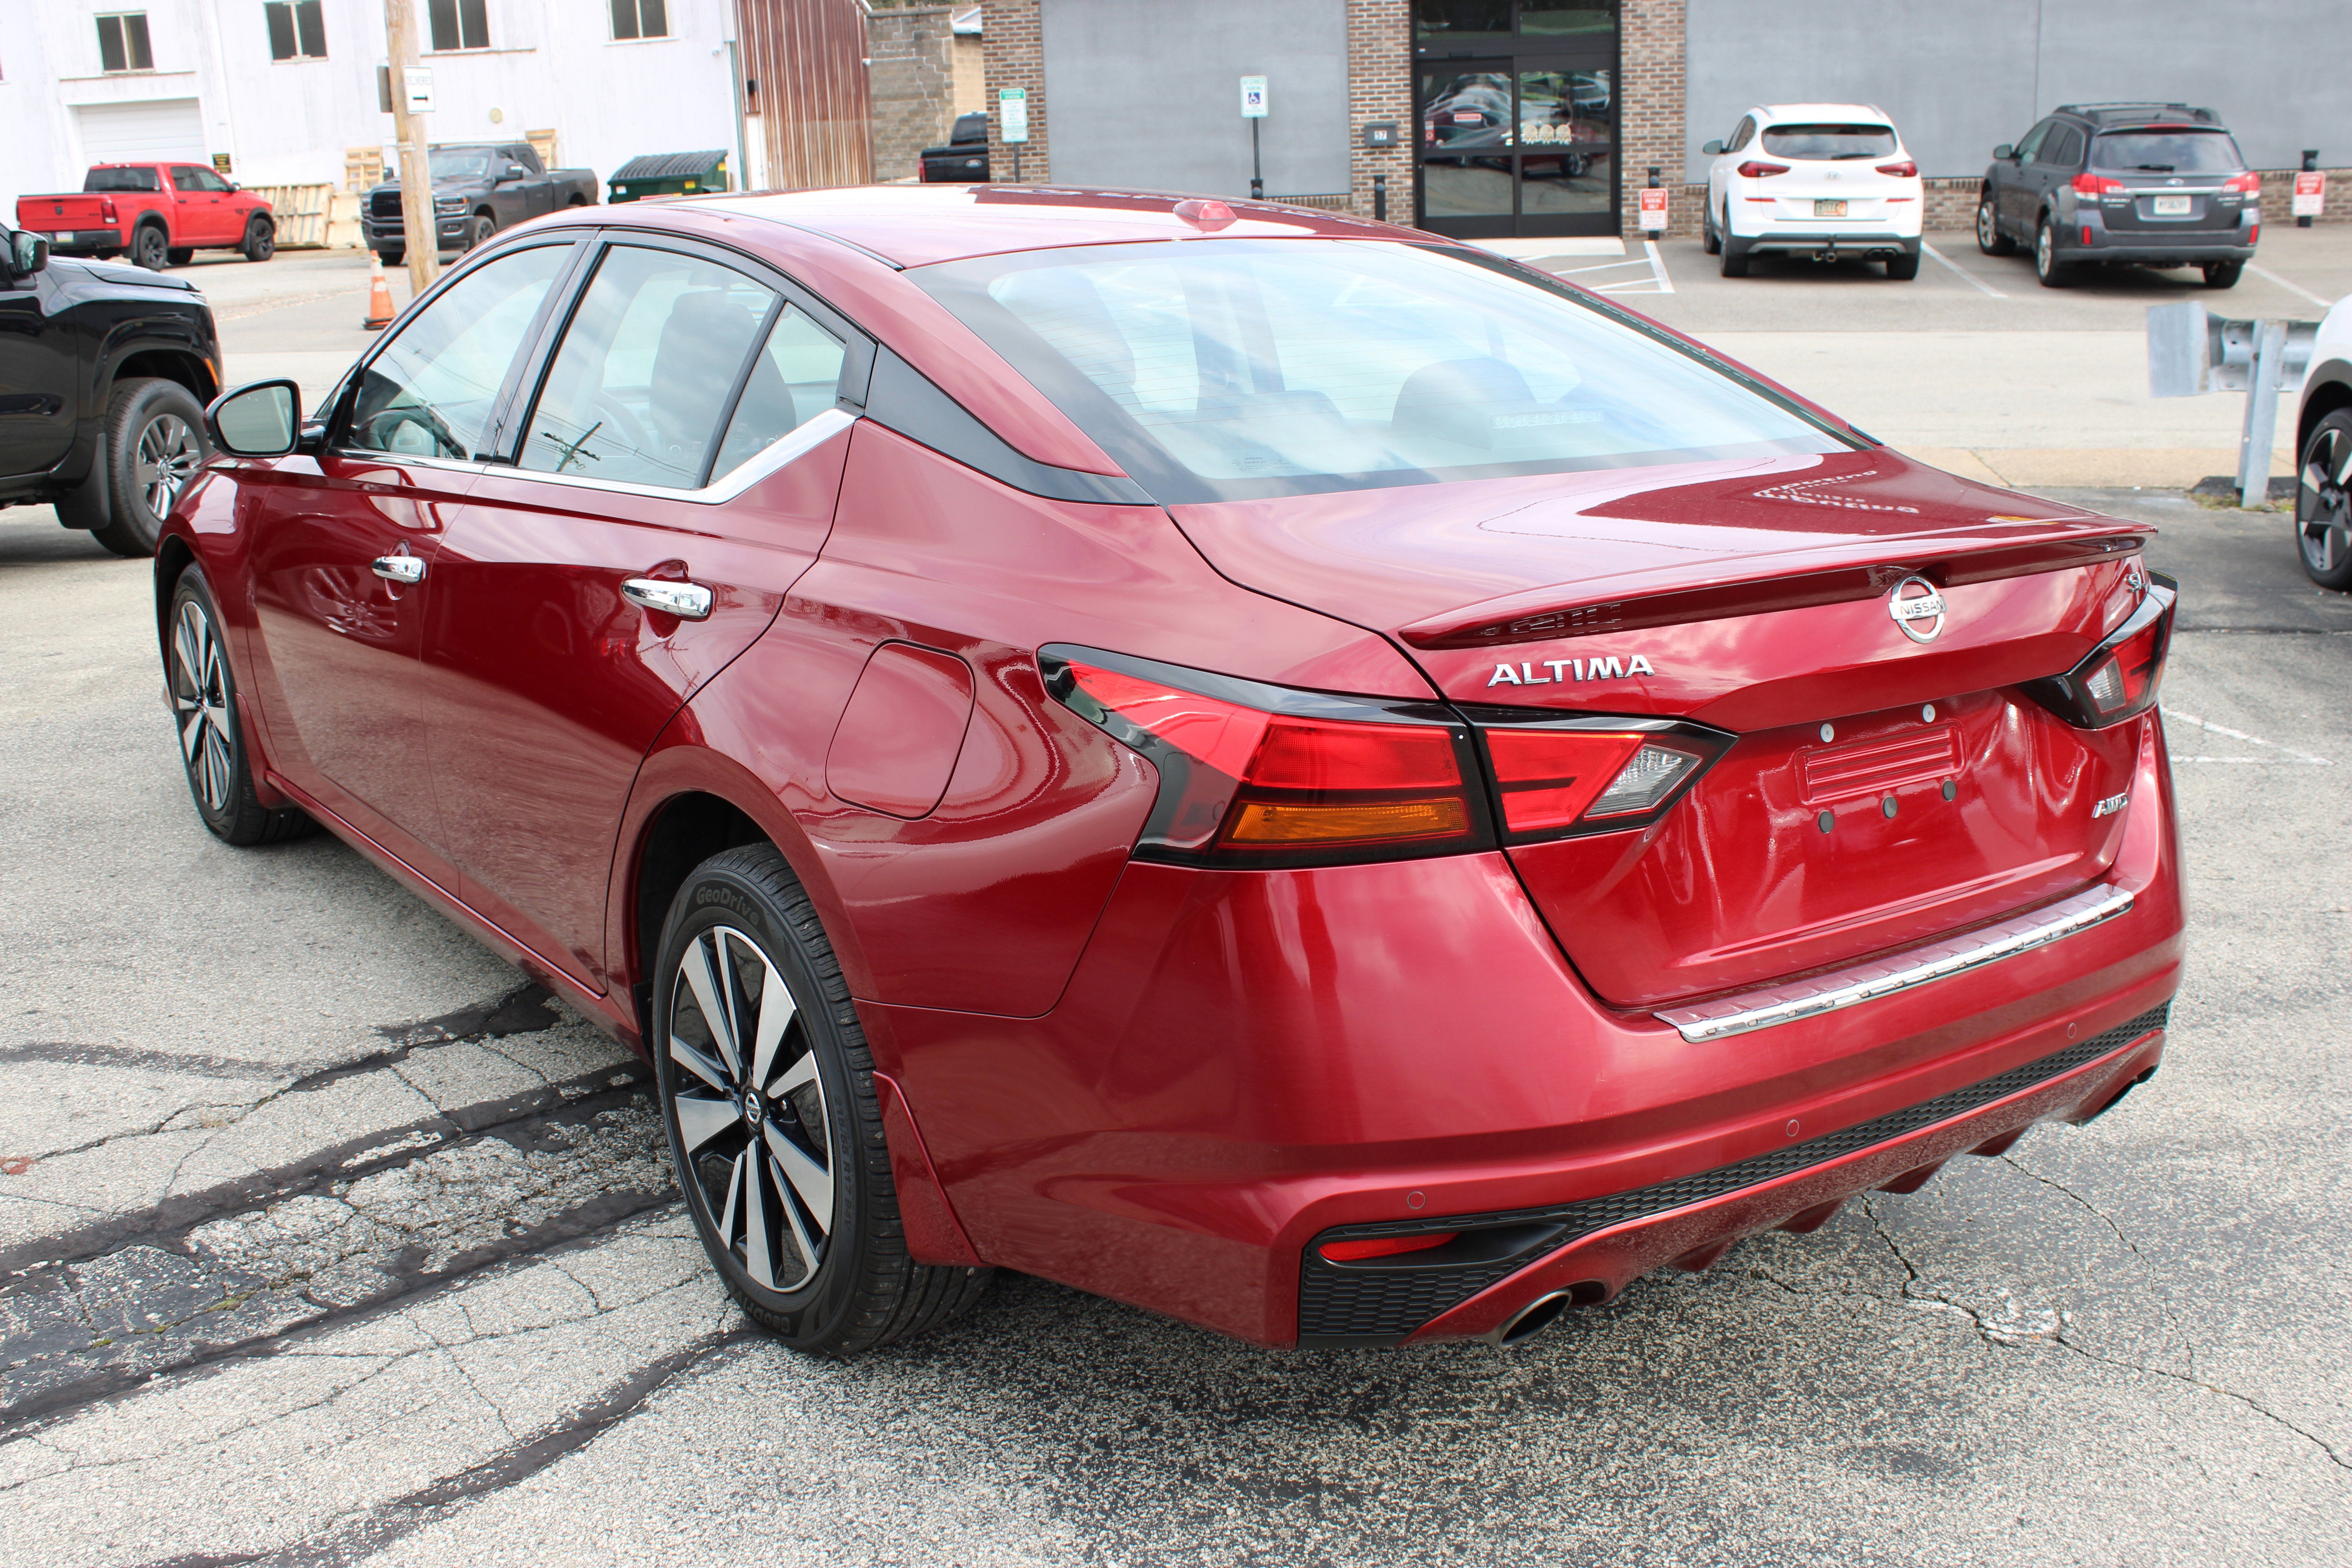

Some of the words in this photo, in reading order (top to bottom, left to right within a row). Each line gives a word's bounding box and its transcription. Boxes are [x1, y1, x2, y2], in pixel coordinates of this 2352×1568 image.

[1900, 599, 1945, 615] NISSAN
[1486, 654, 1655, 687] ALTIMA
[2092, 792, 2129, 819] AWD
[696, 886, 760, 926] GeoDrive
